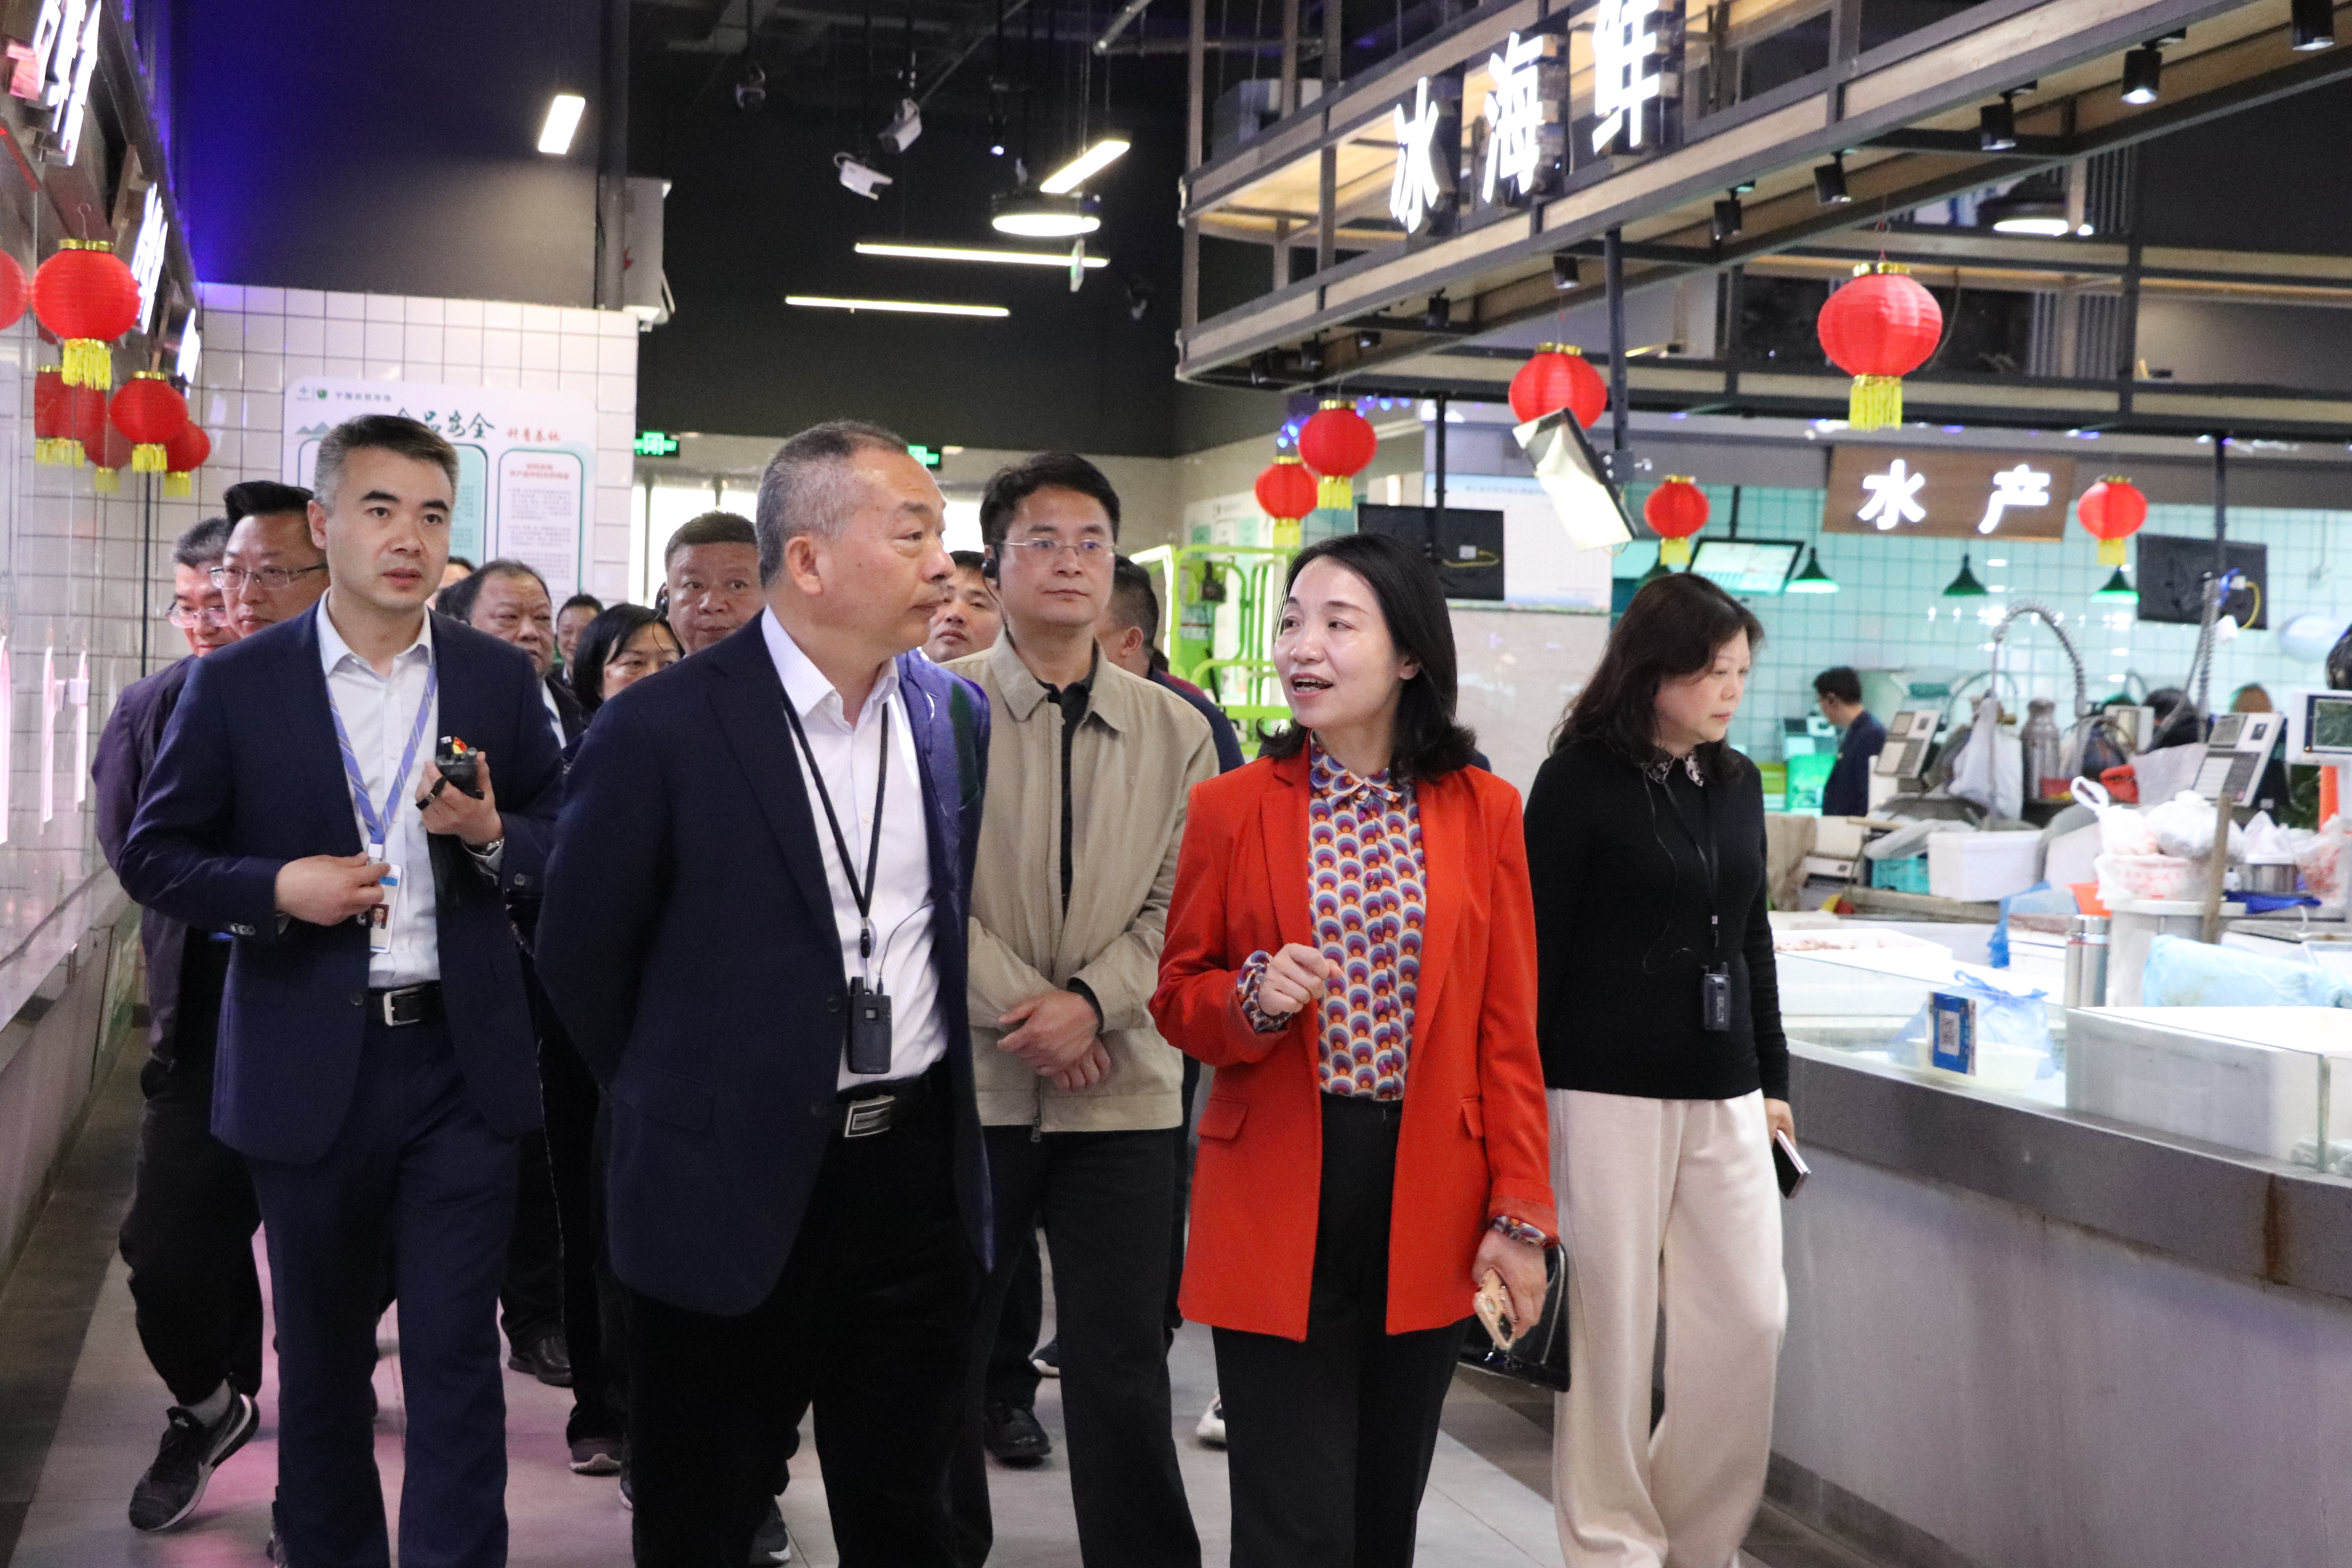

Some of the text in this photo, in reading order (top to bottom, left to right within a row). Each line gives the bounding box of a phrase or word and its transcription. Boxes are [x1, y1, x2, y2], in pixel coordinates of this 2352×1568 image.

[1390, 0, 1660, 234] 冰海鲜
[397, 407, 495, 439] 品安全
[1857, 458, 2051, 535] 水产
